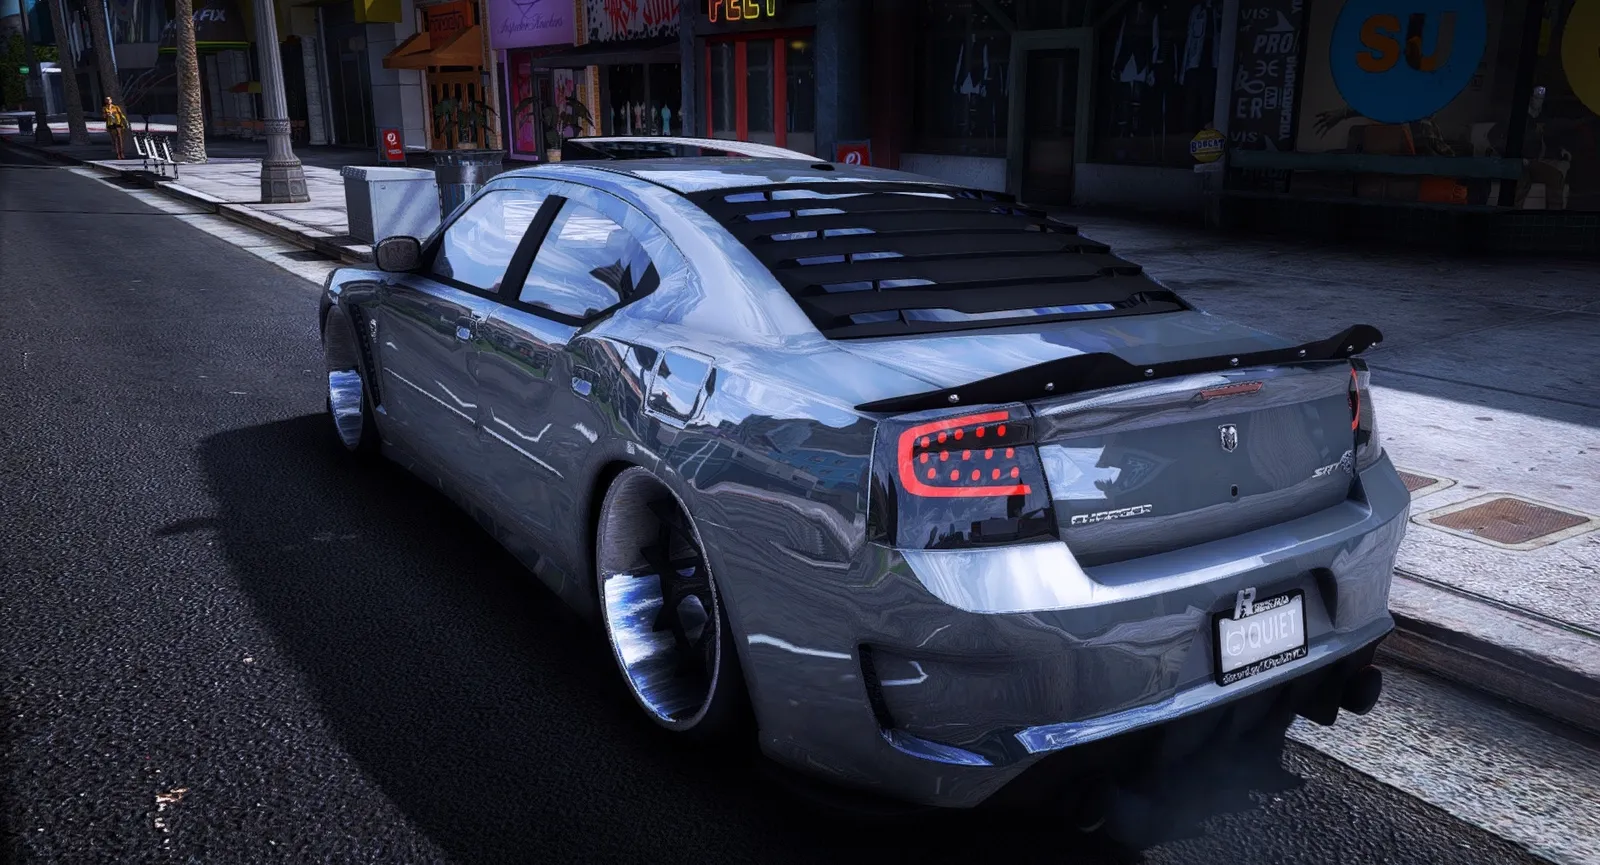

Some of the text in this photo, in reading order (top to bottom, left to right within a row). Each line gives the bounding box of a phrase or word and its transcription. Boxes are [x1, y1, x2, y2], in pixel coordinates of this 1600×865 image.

[1356, 10, 1456, 74] SU
[1191, 139, 1225, 153] BOBCAT
[1248, 608, 1296, 649] QUIET
